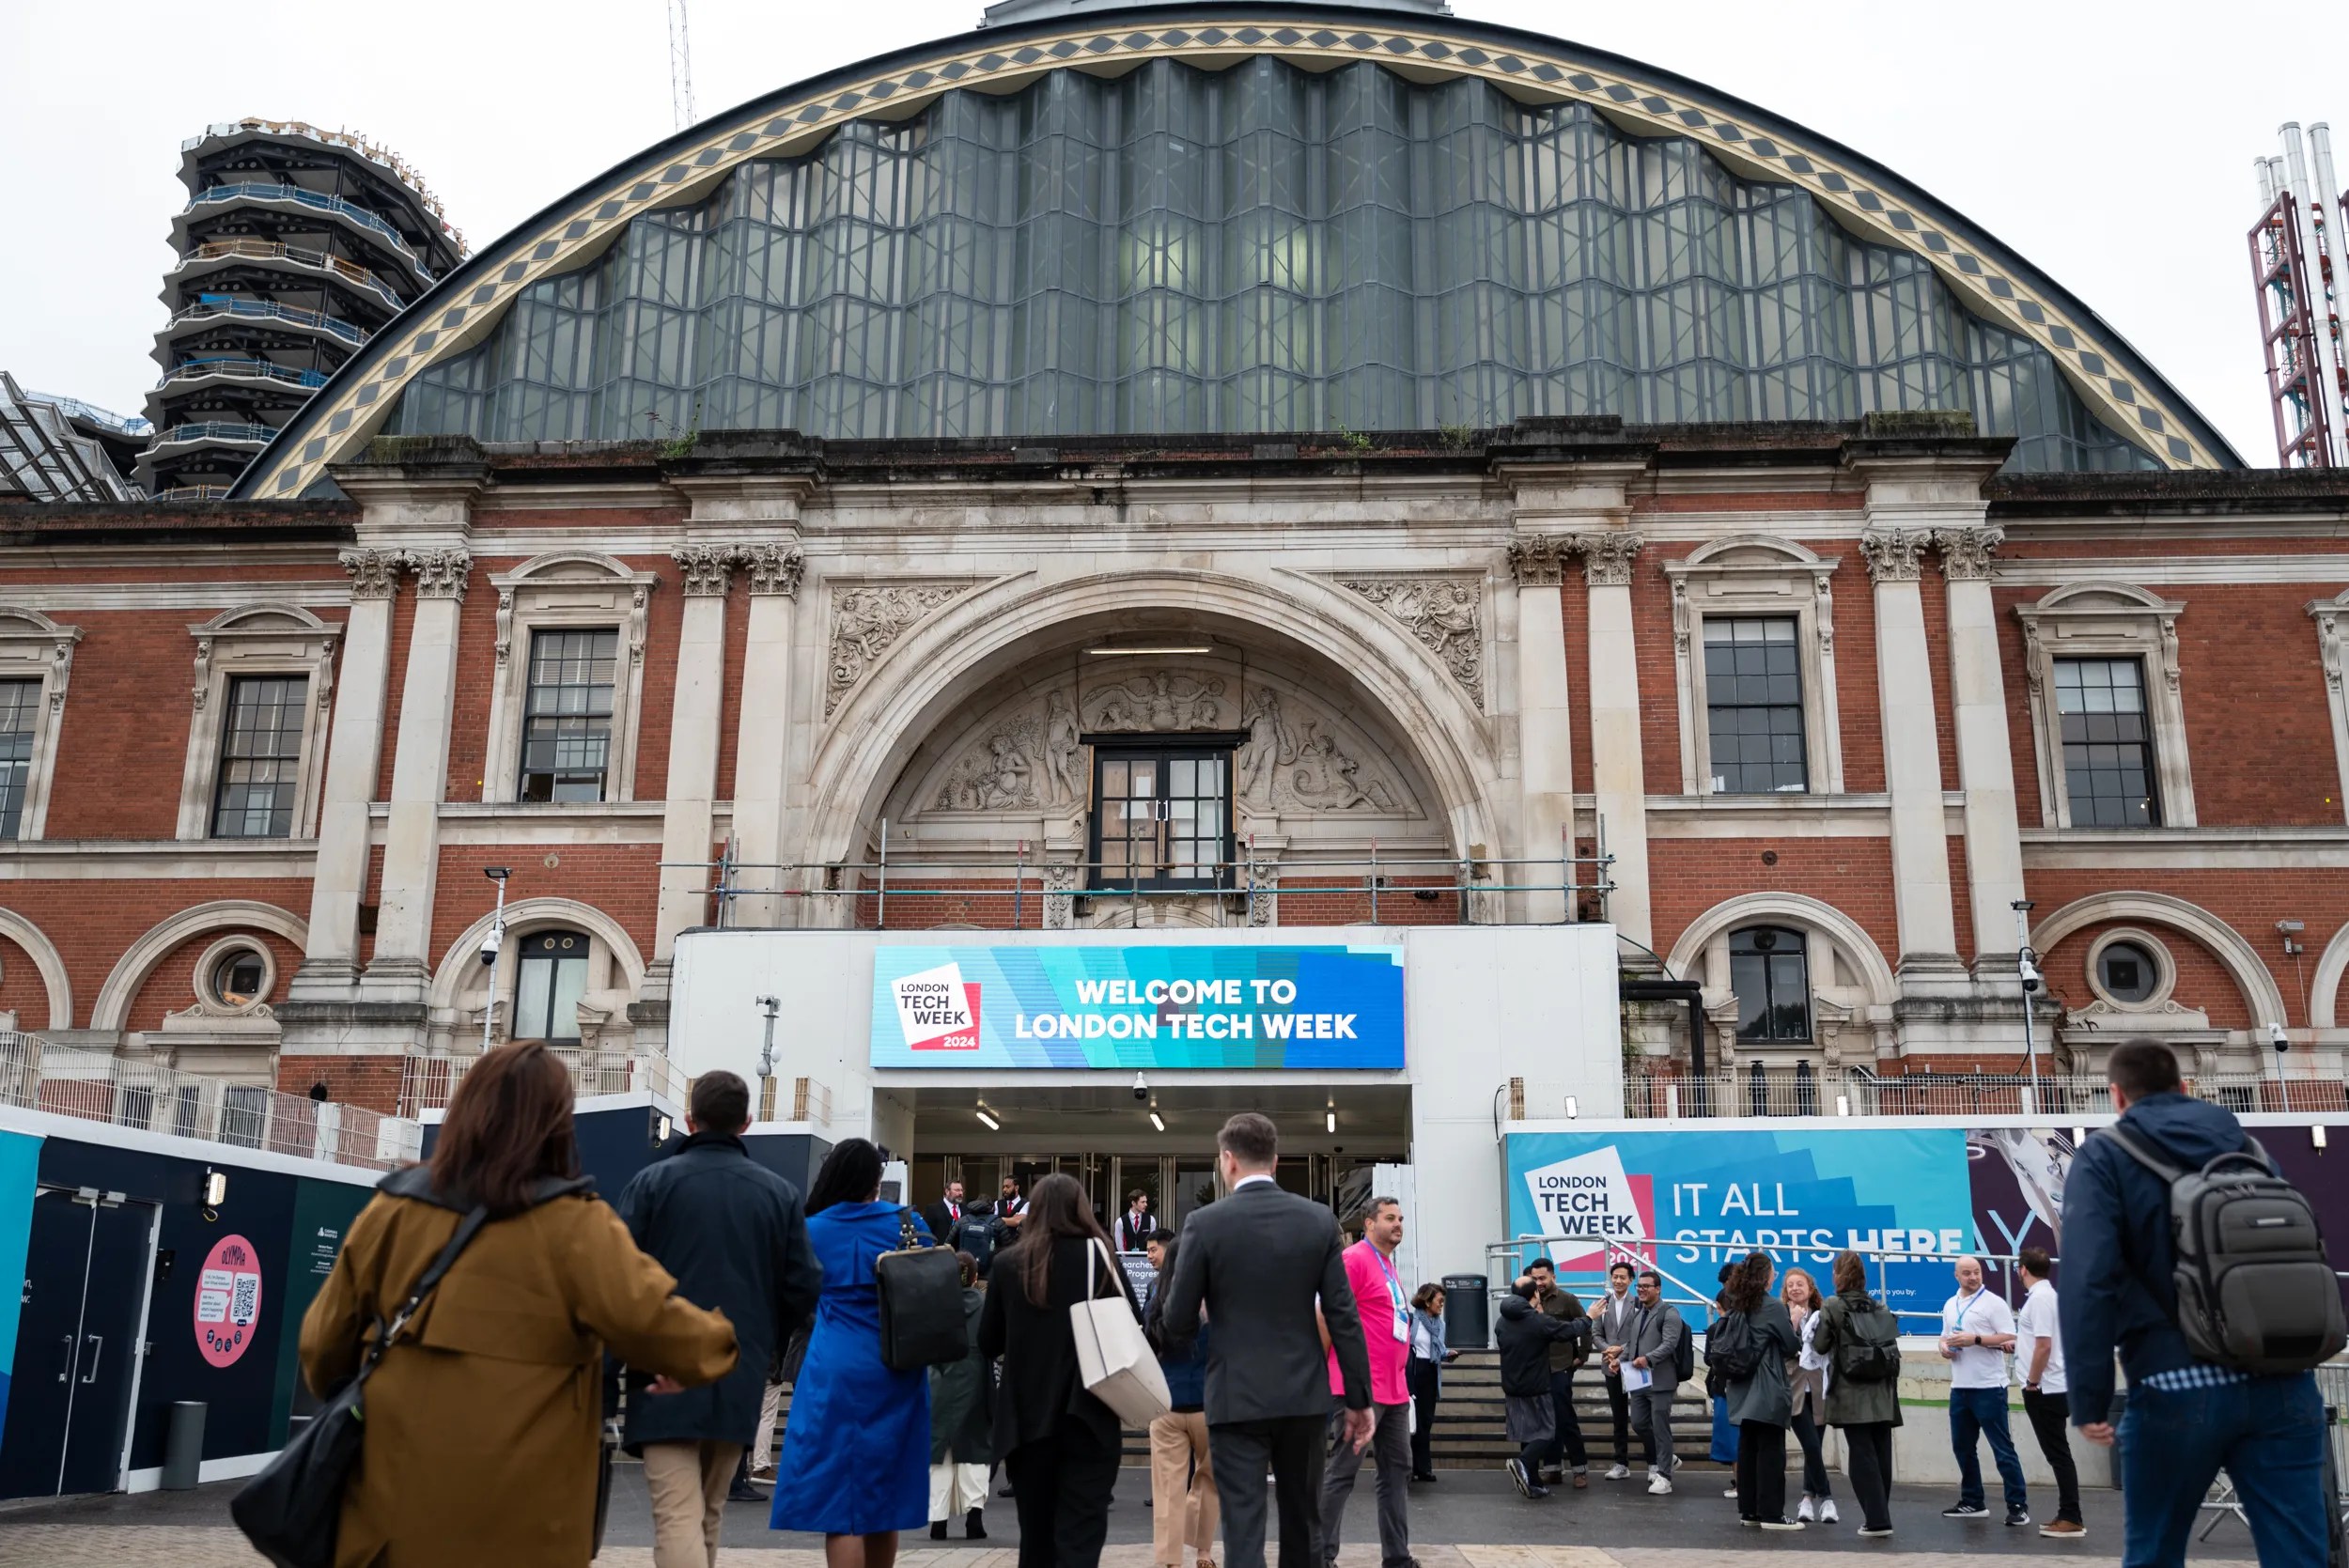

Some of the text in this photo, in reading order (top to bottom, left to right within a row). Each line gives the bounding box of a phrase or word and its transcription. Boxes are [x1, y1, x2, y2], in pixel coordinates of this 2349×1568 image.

[901, 984, 949, 992] LONDON
[1075, 979, 1297, 1004] WELCOME TO
[901, 996, 949, 1009] TECH
[913, 1011, 965, 1025] WEEK
[1015, 1014, 1358, 1039] LONDON TECH WEEK
[943, 1036, 975, 1048] 2024
[1538, 1176, 1607, 1188] LONDON
[1540, 1193, 1609, 1213] TECH
[1673, 1182, 1799, 1217] IT ALL
[1559, 1215, 1634, 1234] WEEK
[1675, 1228, 1962, 1264] STARTS HERE
[222, 1245, 245, 1265] OLYMPIA
[1128, 1269, 1159, 1279] Progres
[1906, 1288, 1917, 1296] by:
